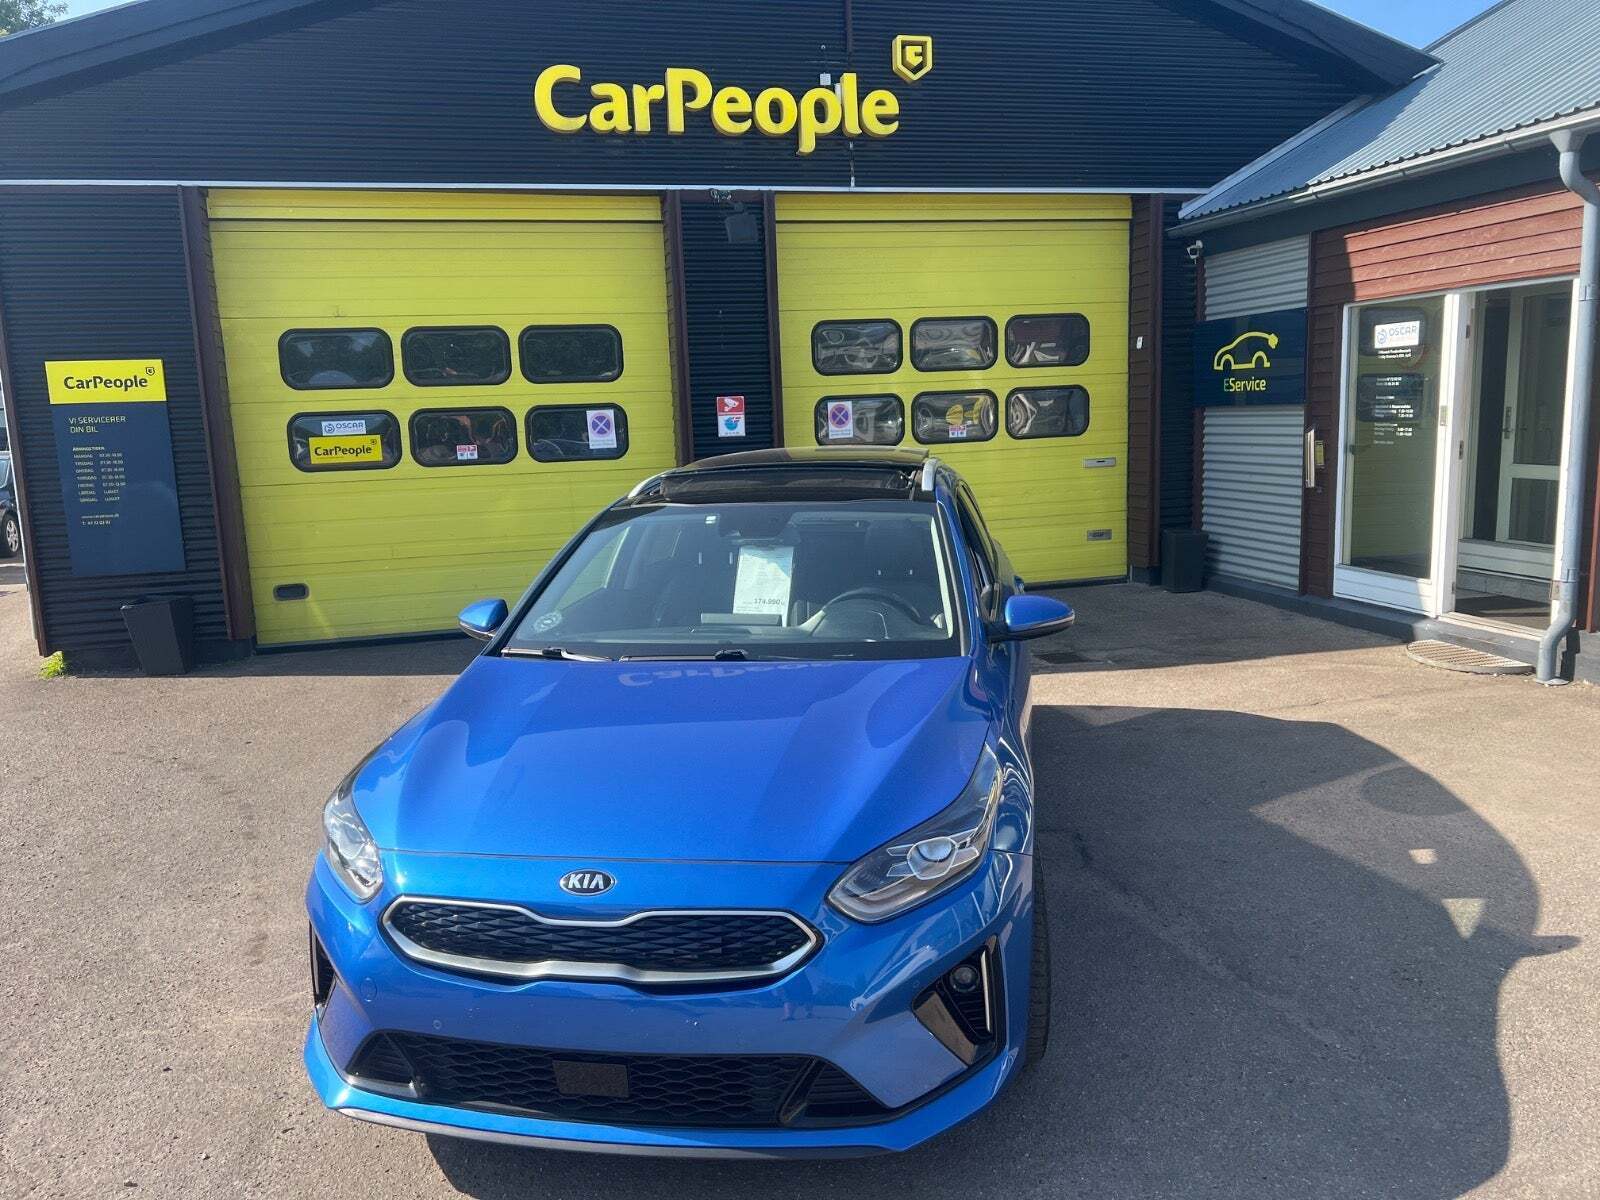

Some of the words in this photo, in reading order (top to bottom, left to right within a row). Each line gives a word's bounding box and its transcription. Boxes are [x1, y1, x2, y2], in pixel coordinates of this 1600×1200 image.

[533, 63, 900, 155] CarPeople
[1388, 325, 1417, 337] OSCAR
[63, 375, 148, 392] CarPeople
[1223, 376, 1266, 392] EService
[70, 426, 84, 434] DIN
[86, 425, 99, 433] BIL
[314, 445, 372, 457] CarPeople
[567, 873, 605, 889] KIA
